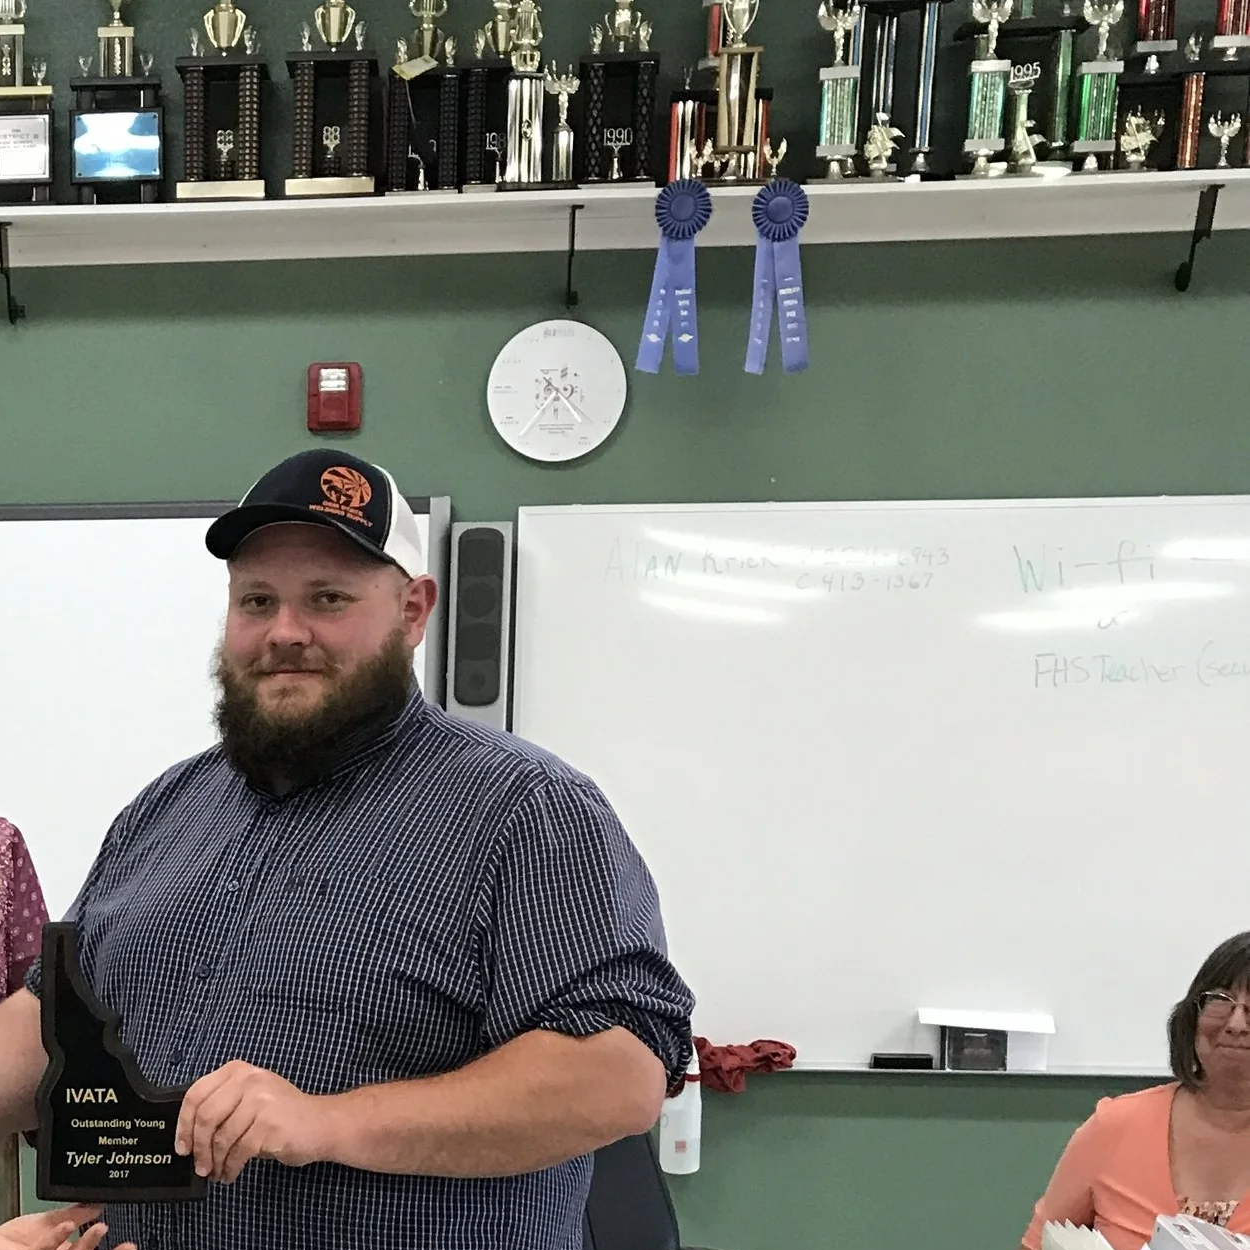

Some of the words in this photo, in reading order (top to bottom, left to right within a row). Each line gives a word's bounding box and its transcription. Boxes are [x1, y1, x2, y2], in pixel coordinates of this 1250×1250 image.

[1009, 62, 1041, 81] 1995
[603, 128, 633, 145] 1990
[66, 1088, 118, 1103] IVATA
[71, 1118, 131, 1130] Outstanding
[134, 1118, 165, 1129] Young
[98, 1136, 138, 1145] Member
[66, 1152, 103, 1167] Tyler
[106, 1151, 172, 1165] Johnson
[109, 1170, 129, 1178] 2017
